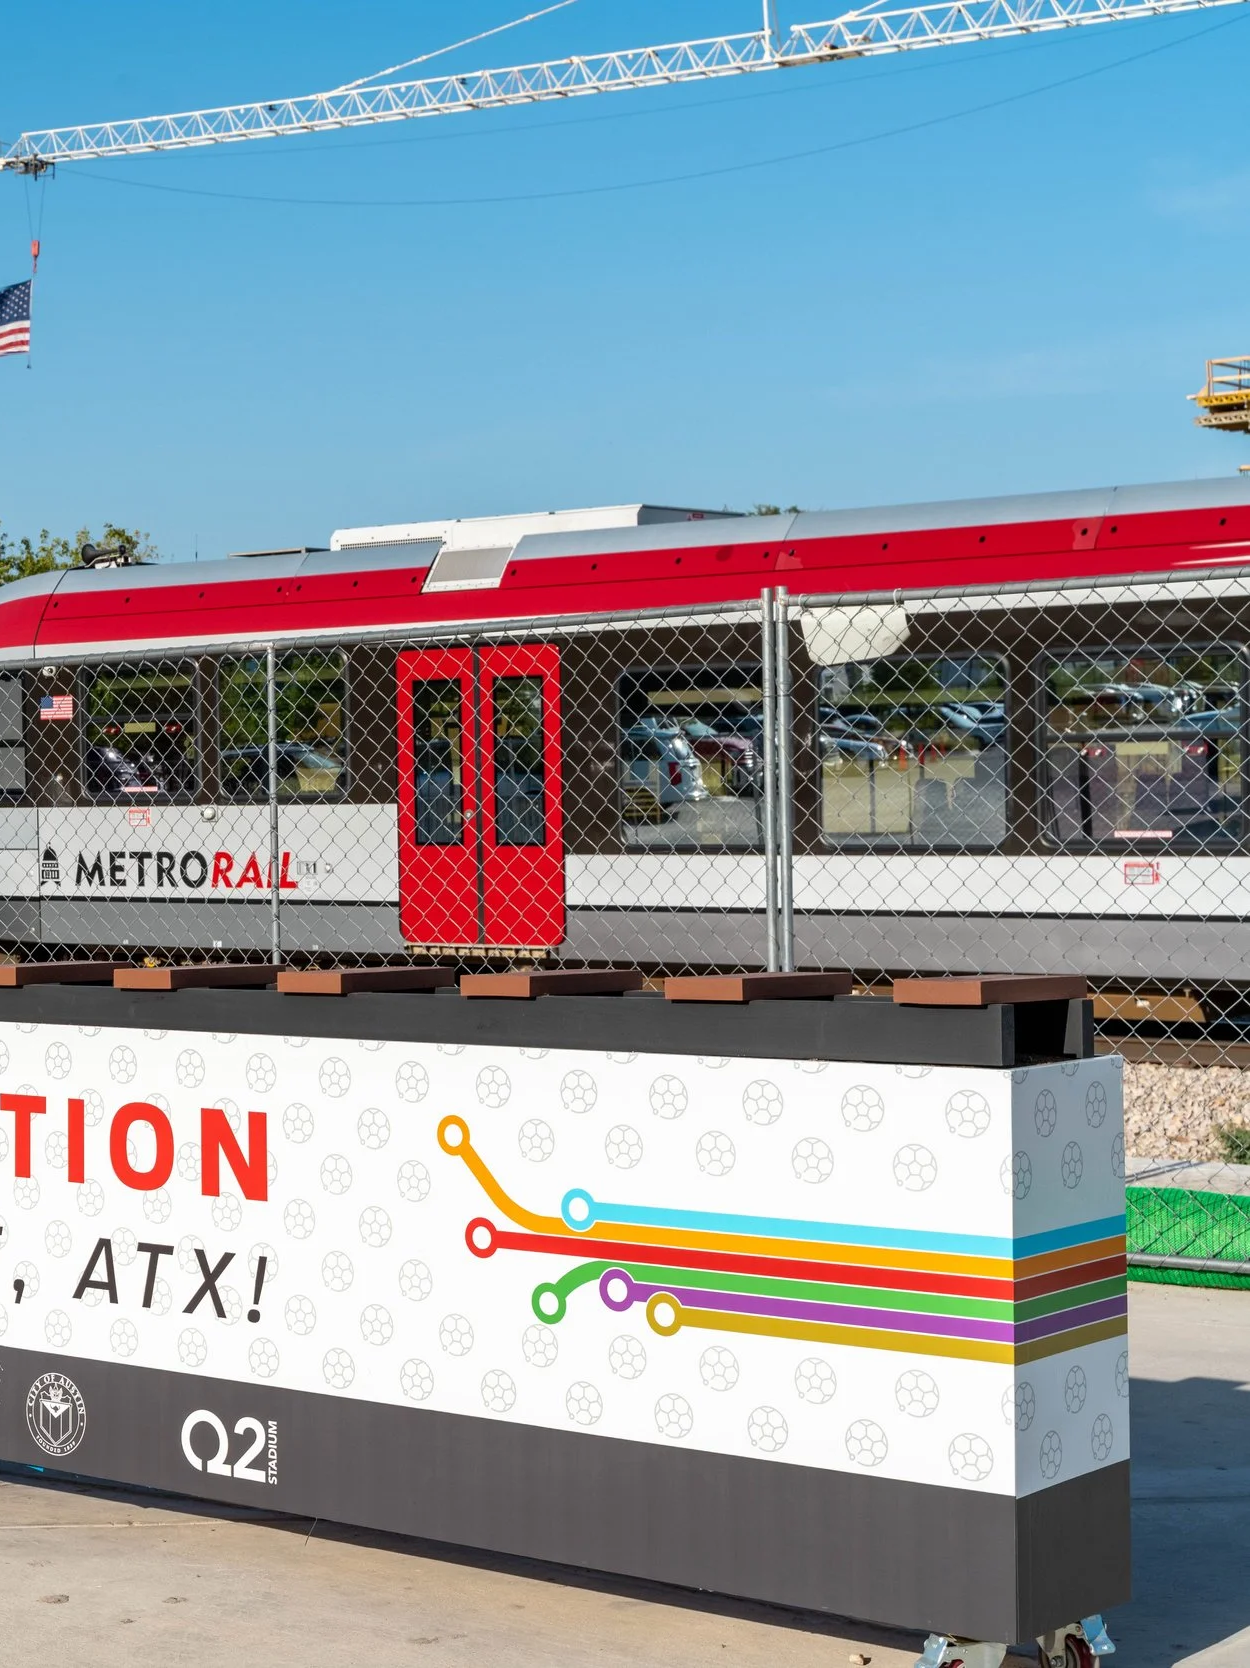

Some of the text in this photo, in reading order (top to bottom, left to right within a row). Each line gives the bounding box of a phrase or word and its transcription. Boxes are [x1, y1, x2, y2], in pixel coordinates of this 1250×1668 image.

[72, 1237, 268, 1324] ATX!
[28, 1374, 85, 1414] CITY OF AUSTIN
[268, 1420, 278, 1485] STADIUM
